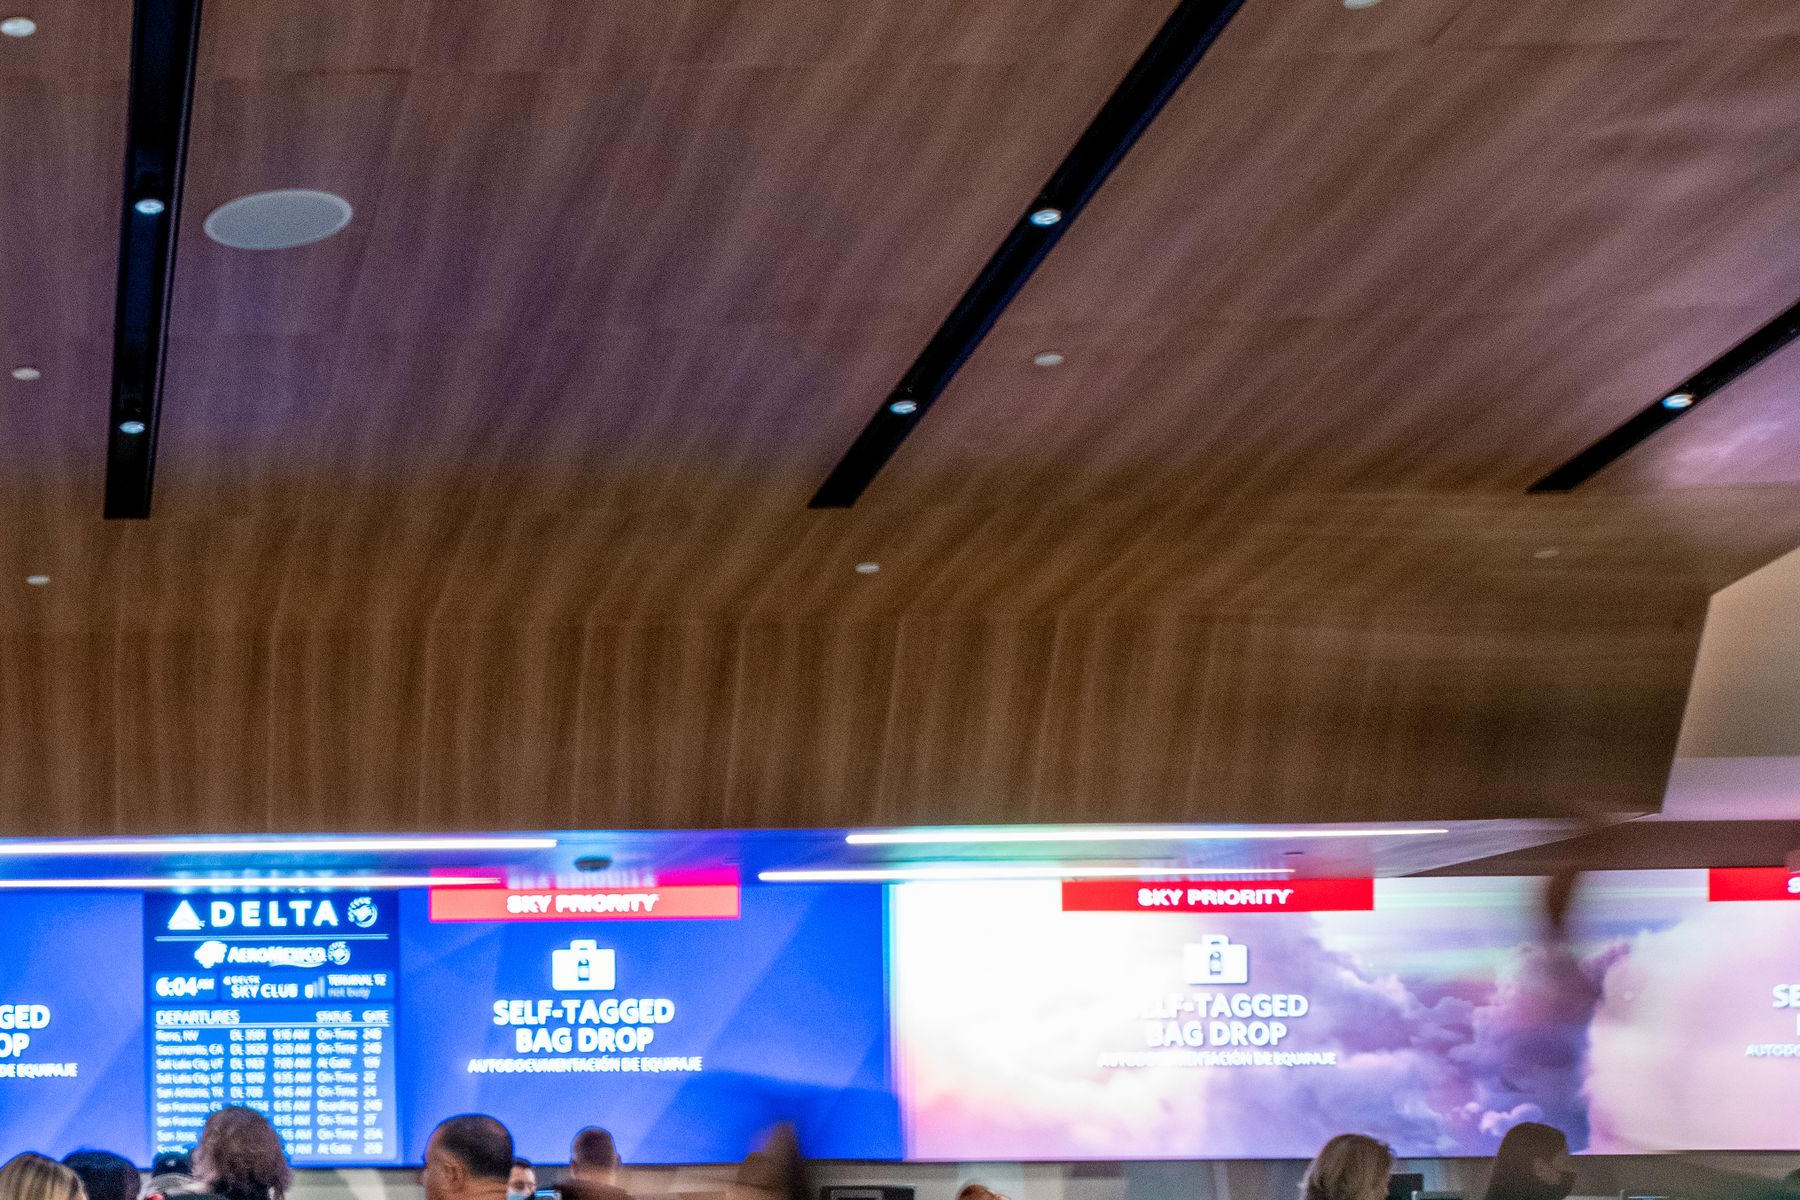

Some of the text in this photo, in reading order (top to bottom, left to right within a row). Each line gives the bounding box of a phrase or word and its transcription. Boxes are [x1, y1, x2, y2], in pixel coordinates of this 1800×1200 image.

[507, 894, 656, 913] SKY PRIORITY
[1138, 889, 1289, 905] SKY PRIORITY
[210, 900, 338, 927] DELTA
[327, 974, 373, 986] TERMINAL
[231, 983, 298, 998] SKY CLUB
[347, 988, 370, 999] busy
[156, 1010, 240, 1025] DEPARTURES
[316, 1010, 389, 1022] STATUS GATE
[493, 998, 675, 1025] SELF-TAGGED
[316, 1028, 358, 1040] On-Time
[516, 1027, 654, 1053] BAG DROP
[1146, 1021, 1287, 1047] BAG DROP
[316, 1042, 358, 1054] On-Time
[328, 1056, 352, 1069] Gate
[468, 1055, 703, 1073] AUTODOCUMENTACIÓN DE EQUIPAJE
[1253, 1052, 1273, 1065] DE
[17, 1063, 78, 1078] EQUIPAJE
[316, 1071, 358, 1083] On-Time
[317, 1085, 358, 1097] On-Time
[317, 1100, 358, 1114] Boarding
[317, 1114, 358, 1126] On-Time
[317, 1128, 358, 1140] On-Time
[330, 1143, 352, 1155] Gate
